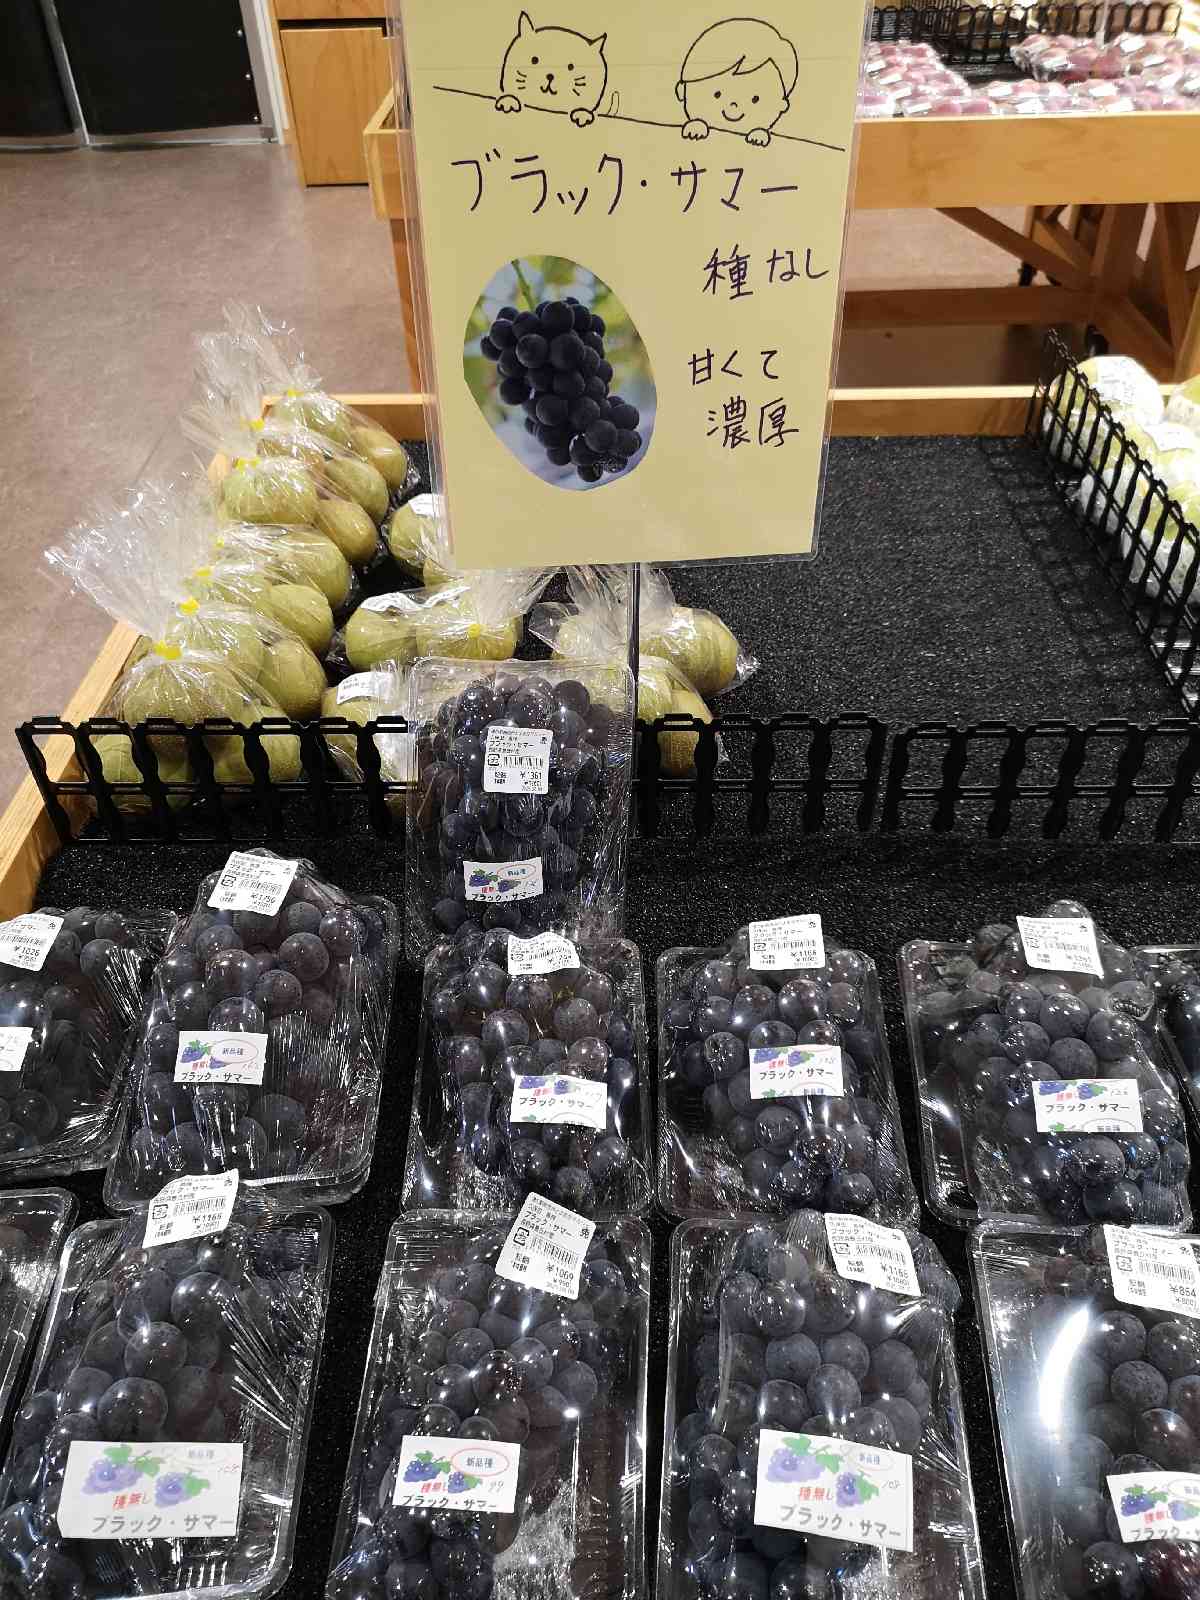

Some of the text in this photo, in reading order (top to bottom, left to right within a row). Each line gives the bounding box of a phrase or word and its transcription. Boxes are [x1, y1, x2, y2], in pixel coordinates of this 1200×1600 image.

[450, 148, 799, 215] ブラック・サマー
[702, 243, 829, 300] 種なし
[688, 348, 780, 386] 甘くて
[706, 396, 800, 449] 濃厚
[222, 1047, 244, 1056] 新品種
[181, 1072, 253, 1081] ブラック・サマー
[759, 1067, 833, 1080] ブラック・サマー
[519, 1097, 594, 1108] ブラック・サマー
[1045, 1103, 1129, 1113] ブラック・サマー
[466, 1457, 494, 1470] 新品種
[799, 1488, 833, 1500] 種無し
[112, 1493, 149, 1510] 種無し
[402, 1495, 497, 1509] ブラック・サマー
[92, 1514, 233, 1533] ブラック・サマー
[780, 1505, 901, 1538] ブラック・サマー
